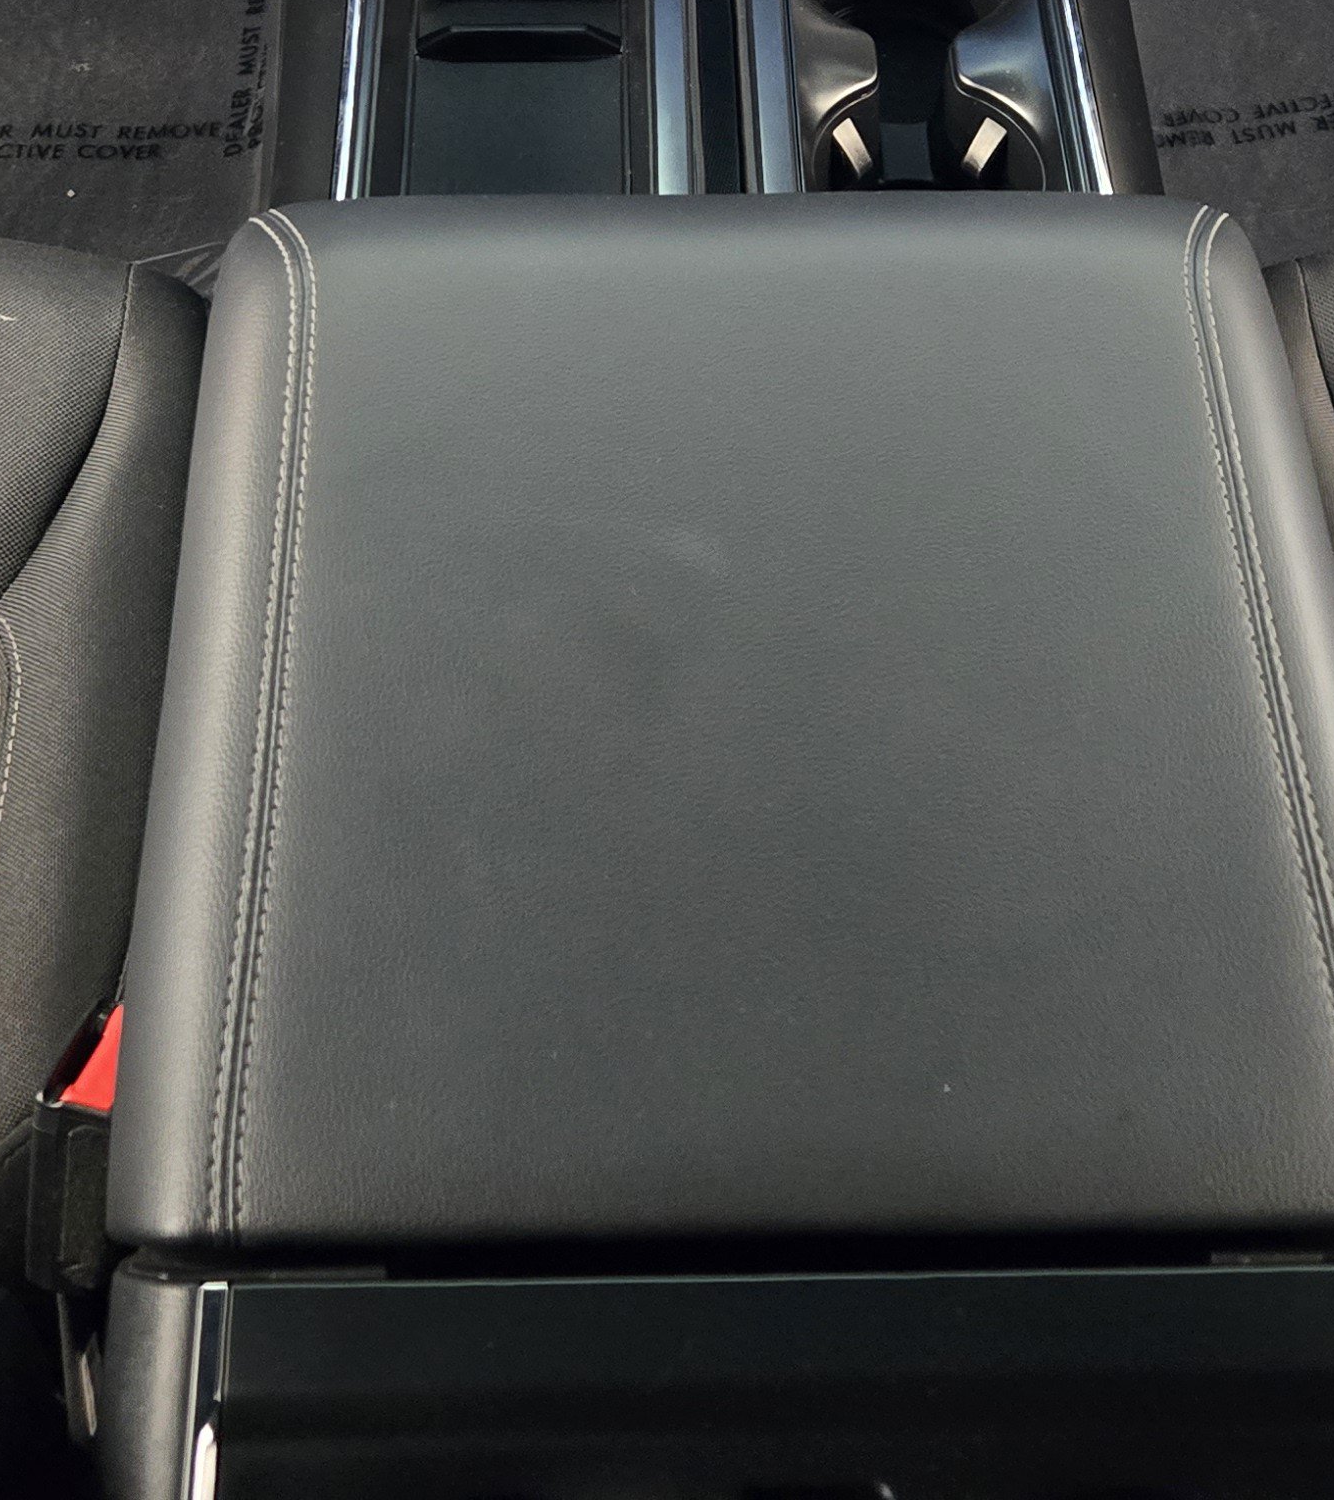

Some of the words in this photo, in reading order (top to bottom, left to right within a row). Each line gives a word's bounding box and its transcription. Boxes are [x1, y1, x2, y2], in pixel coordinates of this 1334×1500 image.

[238, 25, 262, 76] MUST
[30, 122, 104, 140] MUST
[117, 121, 223, 140] REMOVE
[77, 143, 161, 161] COVER
